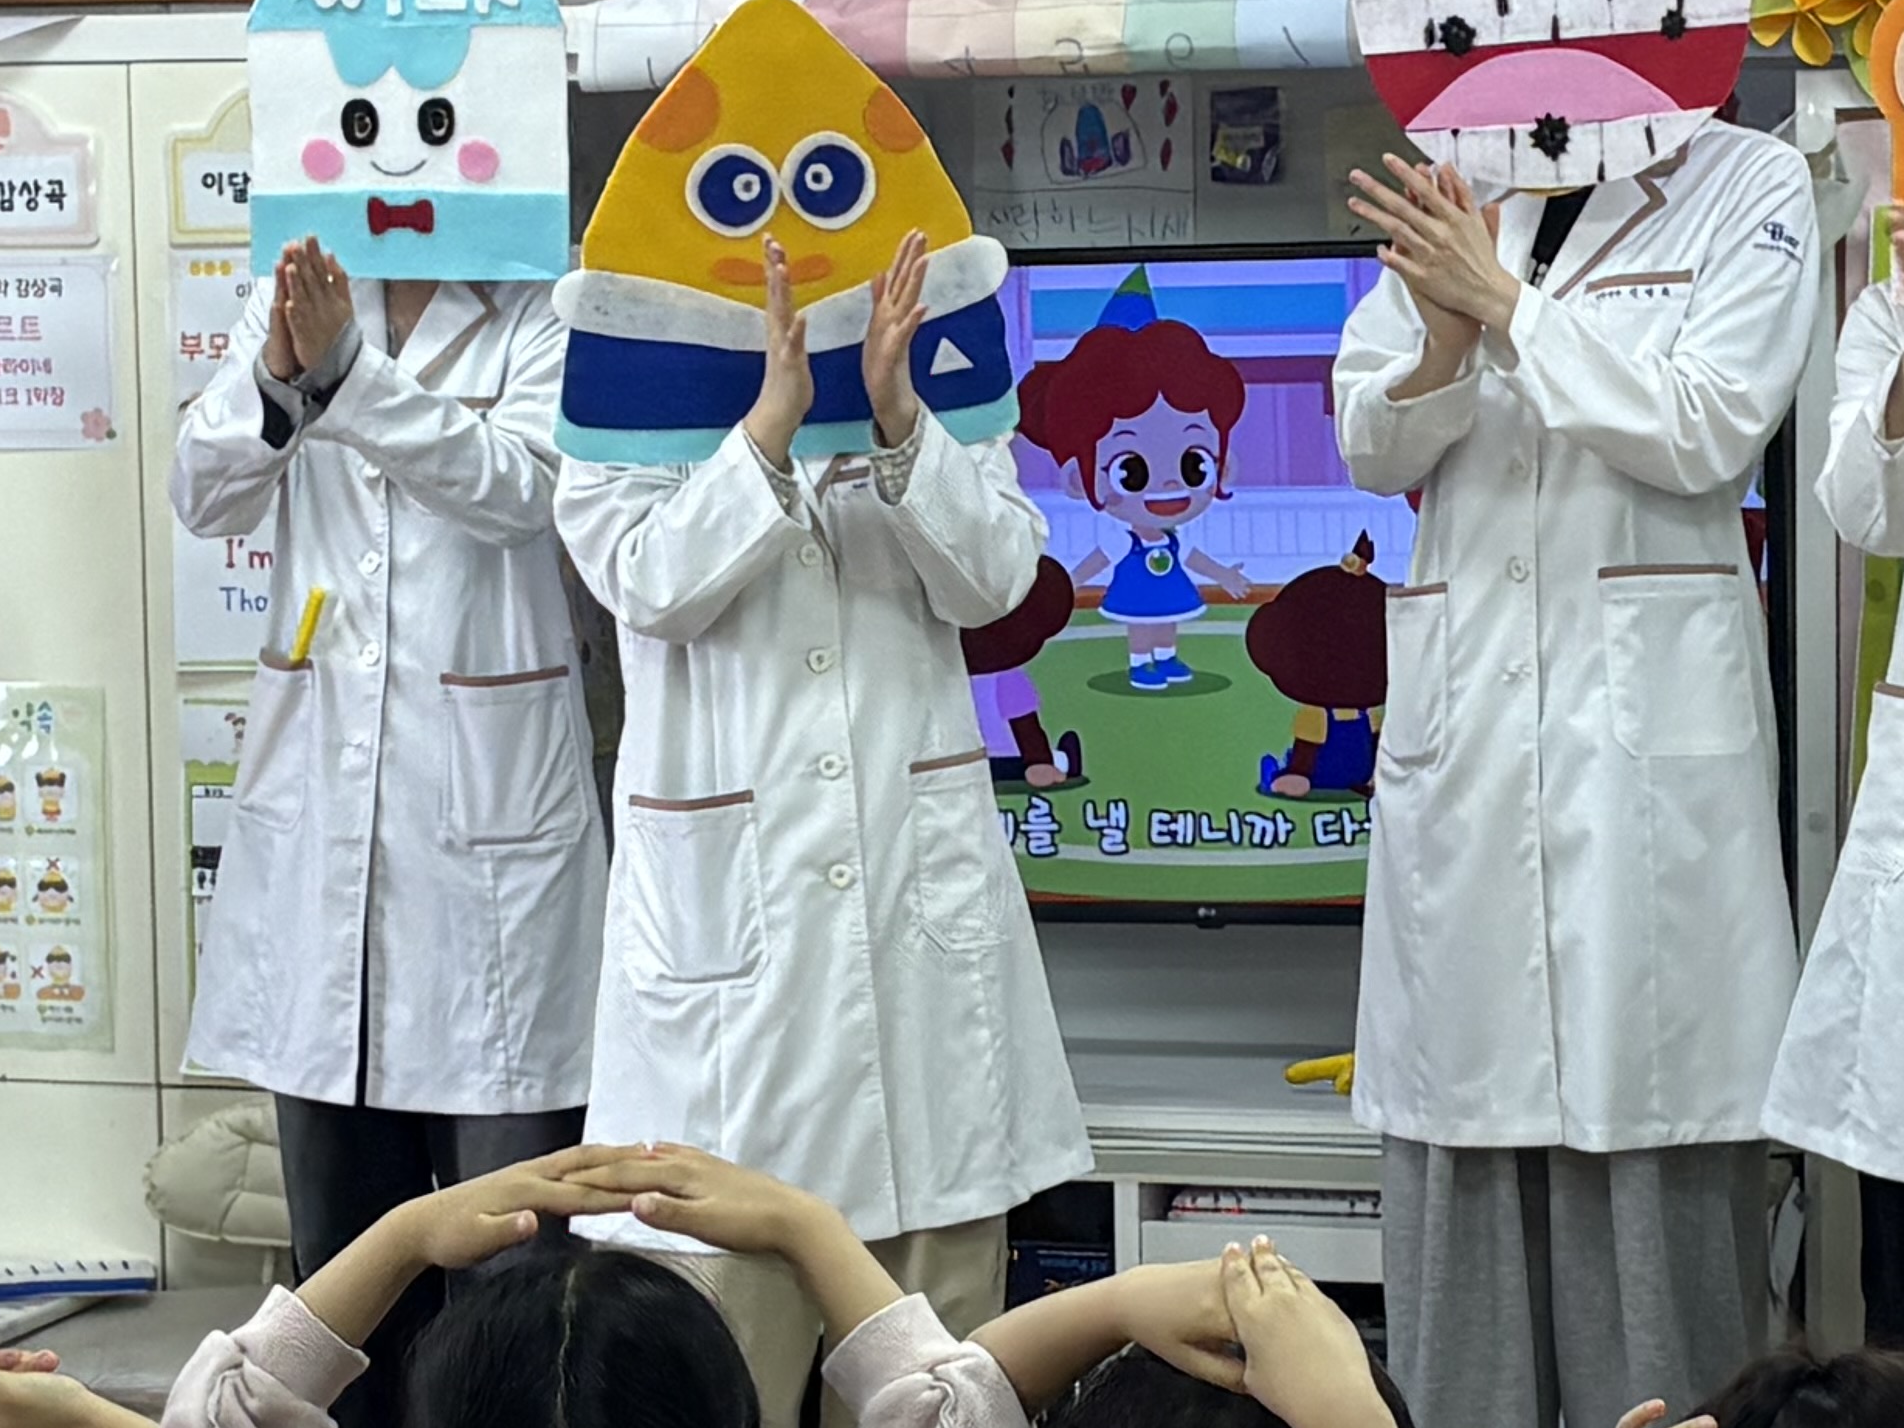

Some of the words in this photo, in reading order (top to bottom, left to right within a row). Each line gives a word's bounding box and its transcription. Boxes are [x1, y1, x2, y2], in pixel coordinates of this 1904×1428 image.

[15, 278, 64, 299] 감상곡
[1084, 798, 1130, 856] 낼
[1147, 808, 1295, 849] 테니까
